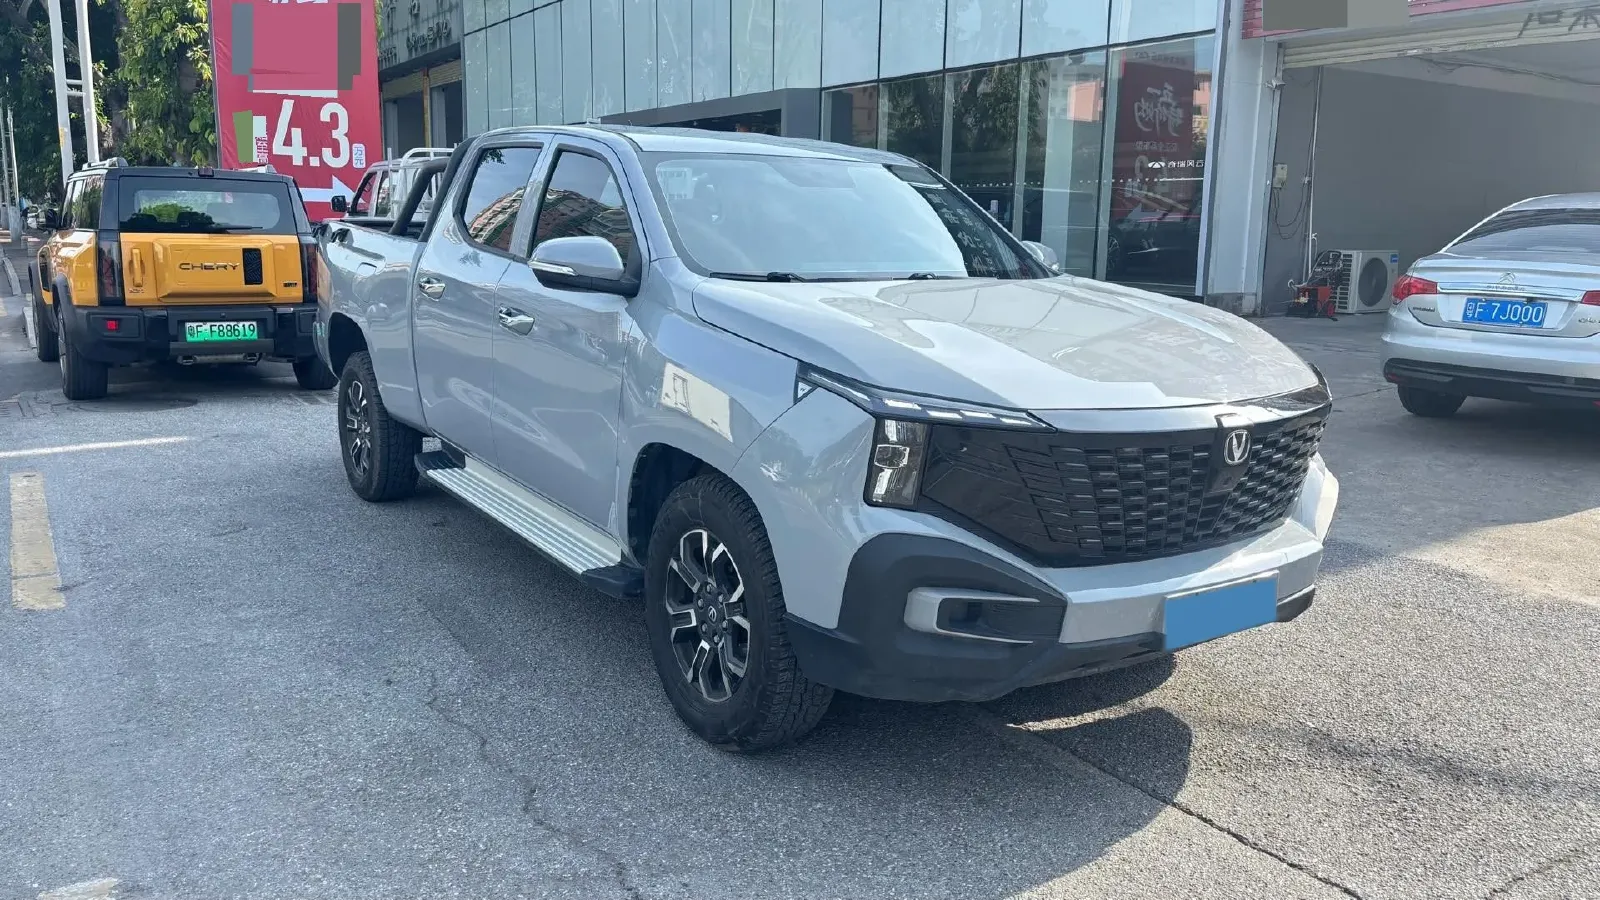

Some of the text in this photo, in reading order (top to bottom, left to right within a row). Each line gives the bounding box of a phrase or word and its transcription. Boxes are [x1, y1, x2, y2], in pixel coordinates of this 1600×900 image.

[272, 99, 350, 168] 4.3
[1167, 159, 1205, 168] 奇瑞风云
[179, 262, 240, 271] CHERY
